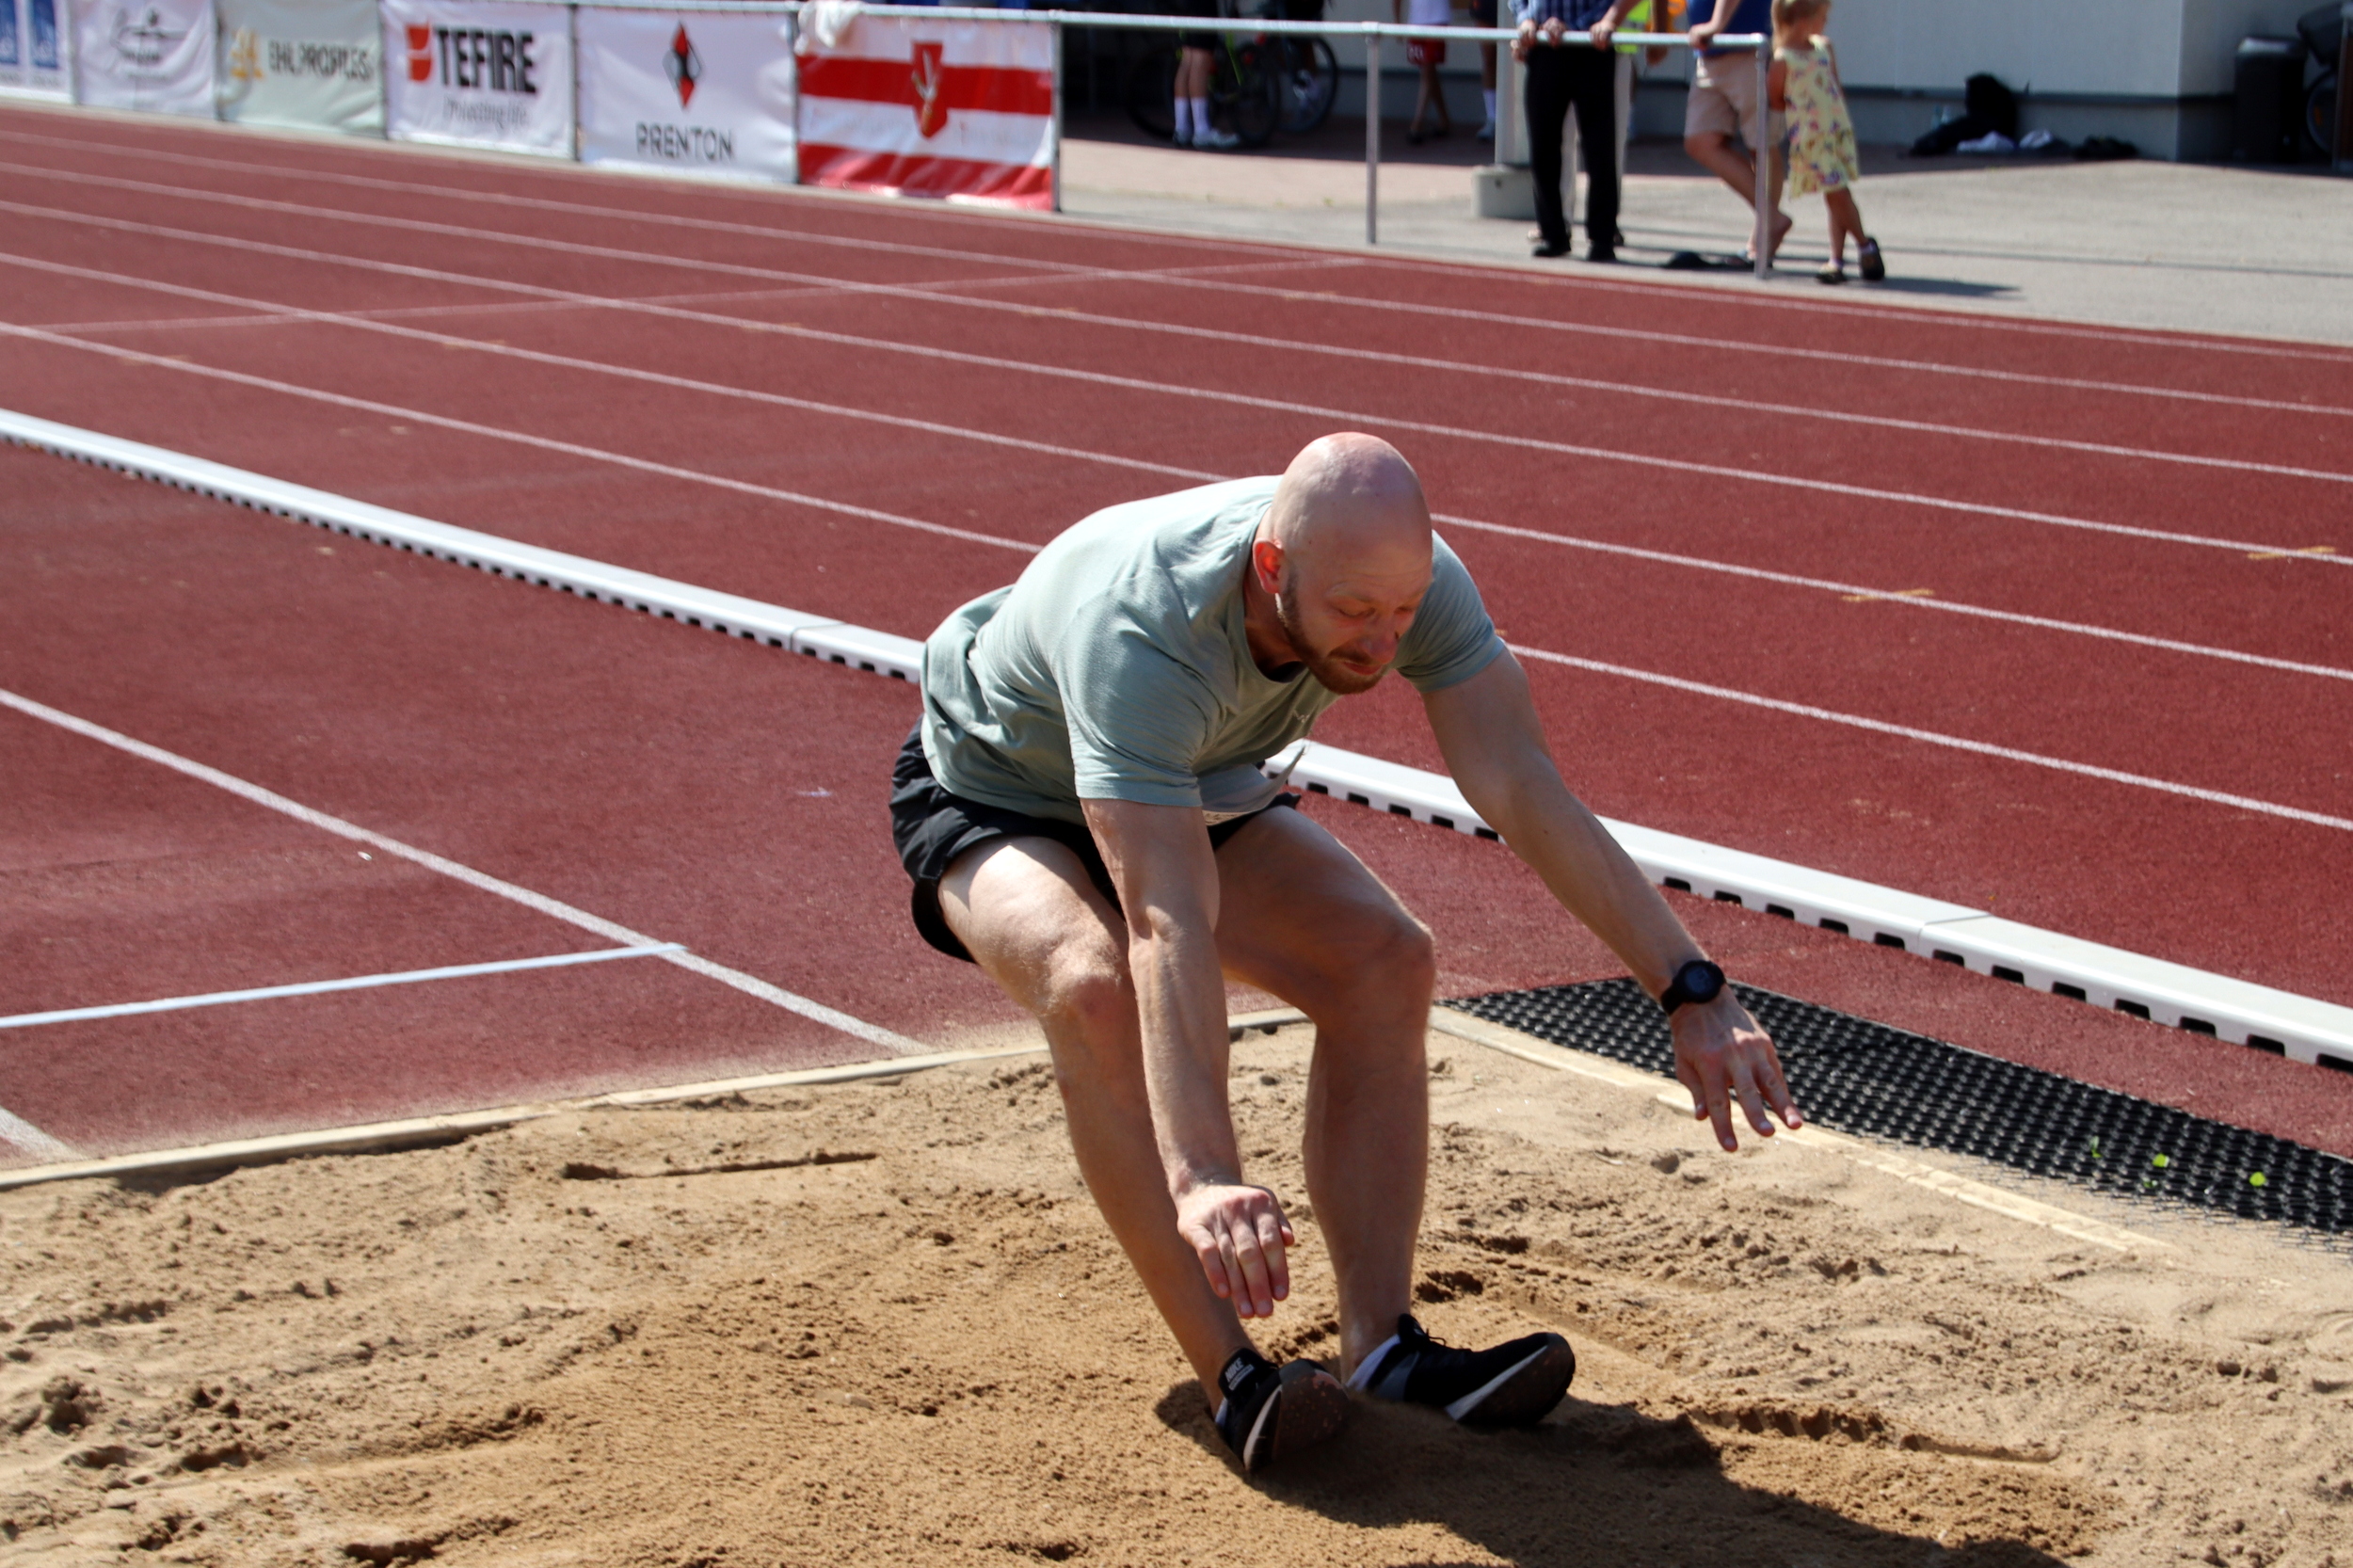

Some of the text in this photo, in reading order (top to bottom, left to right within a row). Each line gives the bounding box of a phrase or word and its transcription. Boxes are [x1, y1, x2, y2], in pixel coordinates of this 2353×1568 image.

[438, 29, 537, 93] TEFIRE
[636, 121, 732, 161] PRENTON
[1225, 1357, 1244, 1382] NIKE
